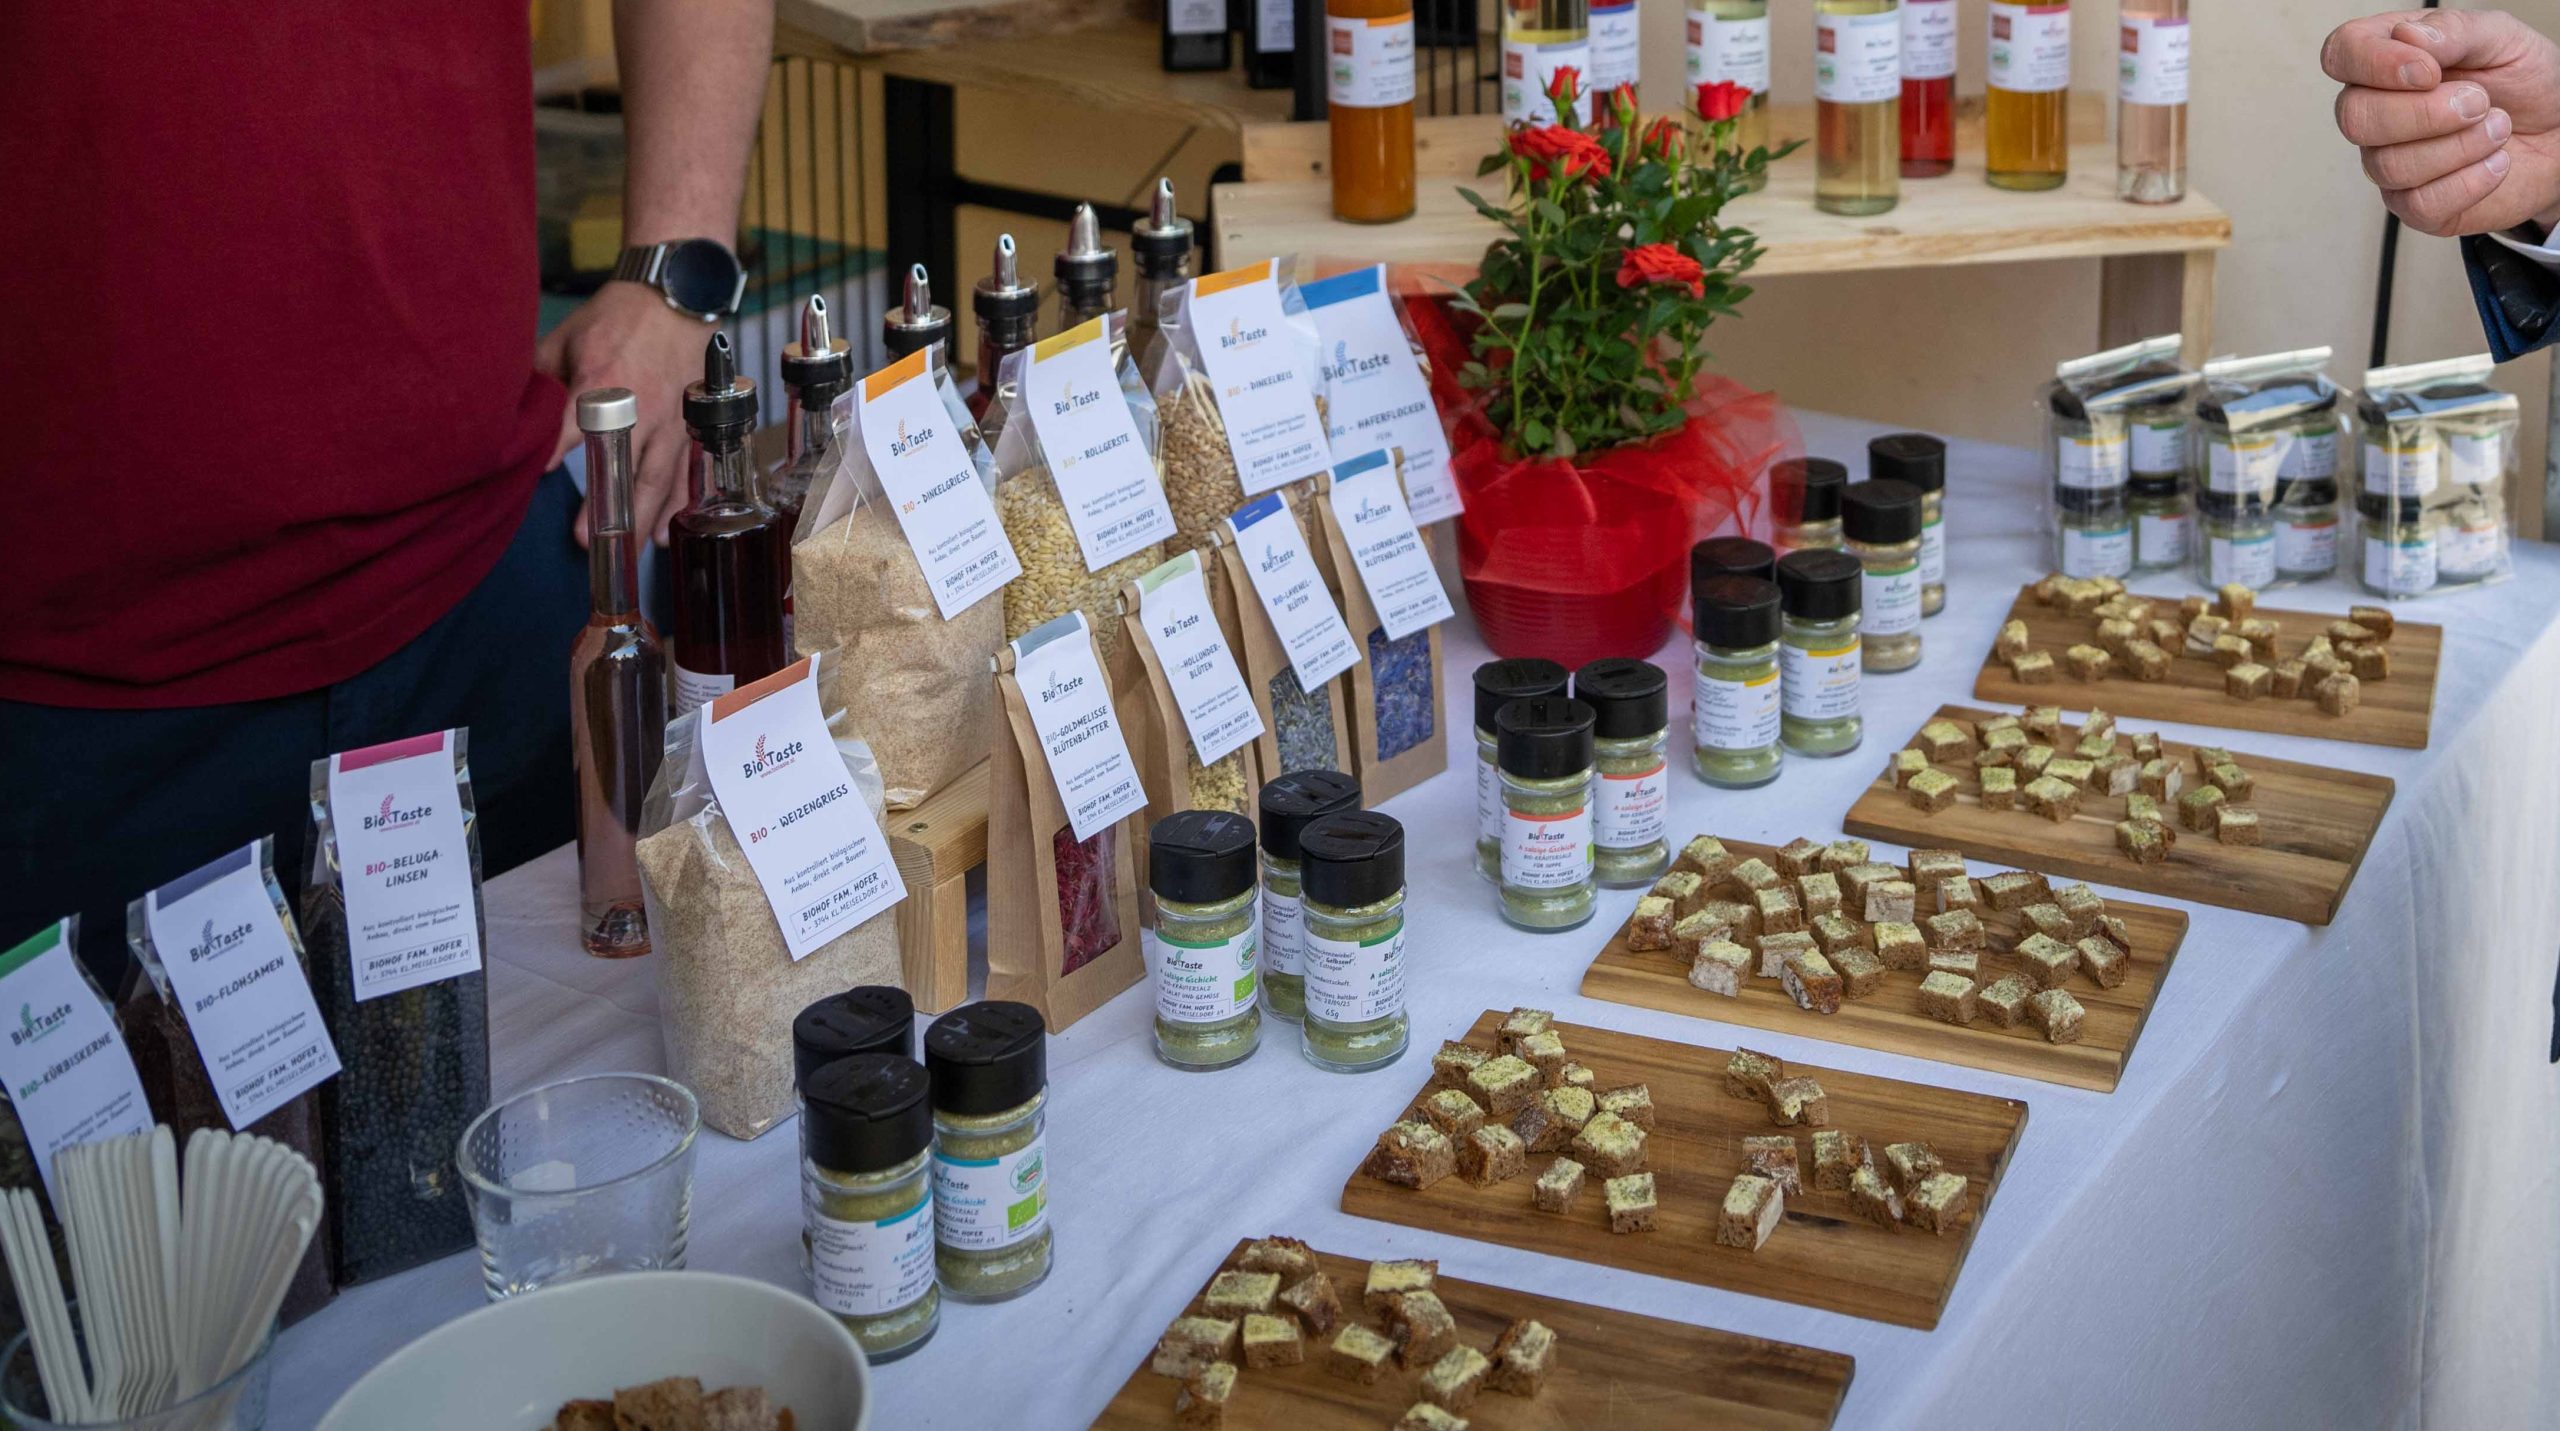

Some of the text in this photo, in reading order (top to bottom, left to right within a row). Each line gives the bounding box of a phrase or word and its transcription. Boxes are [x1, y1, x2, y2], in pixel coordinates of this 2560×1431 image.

[1358, 401, 1427, 430] HAFERFLOCKEN
[891, 427, 934, 456] Bio Taste
[1084, 433, 1130, 460] ROLLGERSTE
[902, 469, 971, 515] BIO DINKELGRIESS
[945, 550, 999, 588] BIOHOF FAM. HOFER
[1189, 661, 1214, 681] BLÜTEN
[1041, 676, 1084, 703] Bio Taste
[1045, 705, 1108, 745] BIO-GOLDMELISSE
[1052, 720, 1110, 756] BLÜTENBLÄTTER
[743, 740, 803, 778] Bio Taste
[749, 826, 768, 843] BIO
[779, 783, 849, 828] WEIZENGRIESS
[1077, 782, 1131, 816] BIOHOF FAM. HOFER
[364, 815, 385, 830] Bio
[391, 805, 432, 823] Taste
[366, 849, 443, 875] BIO-BELUGA-
[783, 835, 866, 886] Aus kontrolliert biologischem
[790, 847, 867, 894] Anbau, direkt vom Bauern!
[386, 869, 428, 887] LINSEN
[801, 926, 806, 936] A
[831, 886, 878, 918] KL.MEISELDORF
[880, 879, 889, 889] 69
[802, 872, 878, 921] BIOHOF FAM. HOFER
[190, 944, 210, 962] Bio
[214, 922, 254, 949] Taste
[369, 939, 462, 970] BIOHOF FAM. HOFER
[1164, 972, 1218, 983] salzige Gschicht
[1167, 957, 1203, 969] Bio Taste
[195, 956, 285, 1013] BIO-FLOHSAMEN
[1164, 980, 1211, 991] BIO-KRÄUTERSALZ
[1167, 989, 1180, 997] SALAT
[11, 1028, 33, 1046] Bio
[36, 1003, 73, 1030] Taste
[1325, 1009, 1340, 1019] 65g
[19, 1032, 113, 1100] BIO-KÜRBISKERNE
[235, 1046, 317, 1099] BIOHOF FAM. HOFER
[947, 1178, 969, 1190] Taste
[951, 1196, 986, 1206] Gschicht
